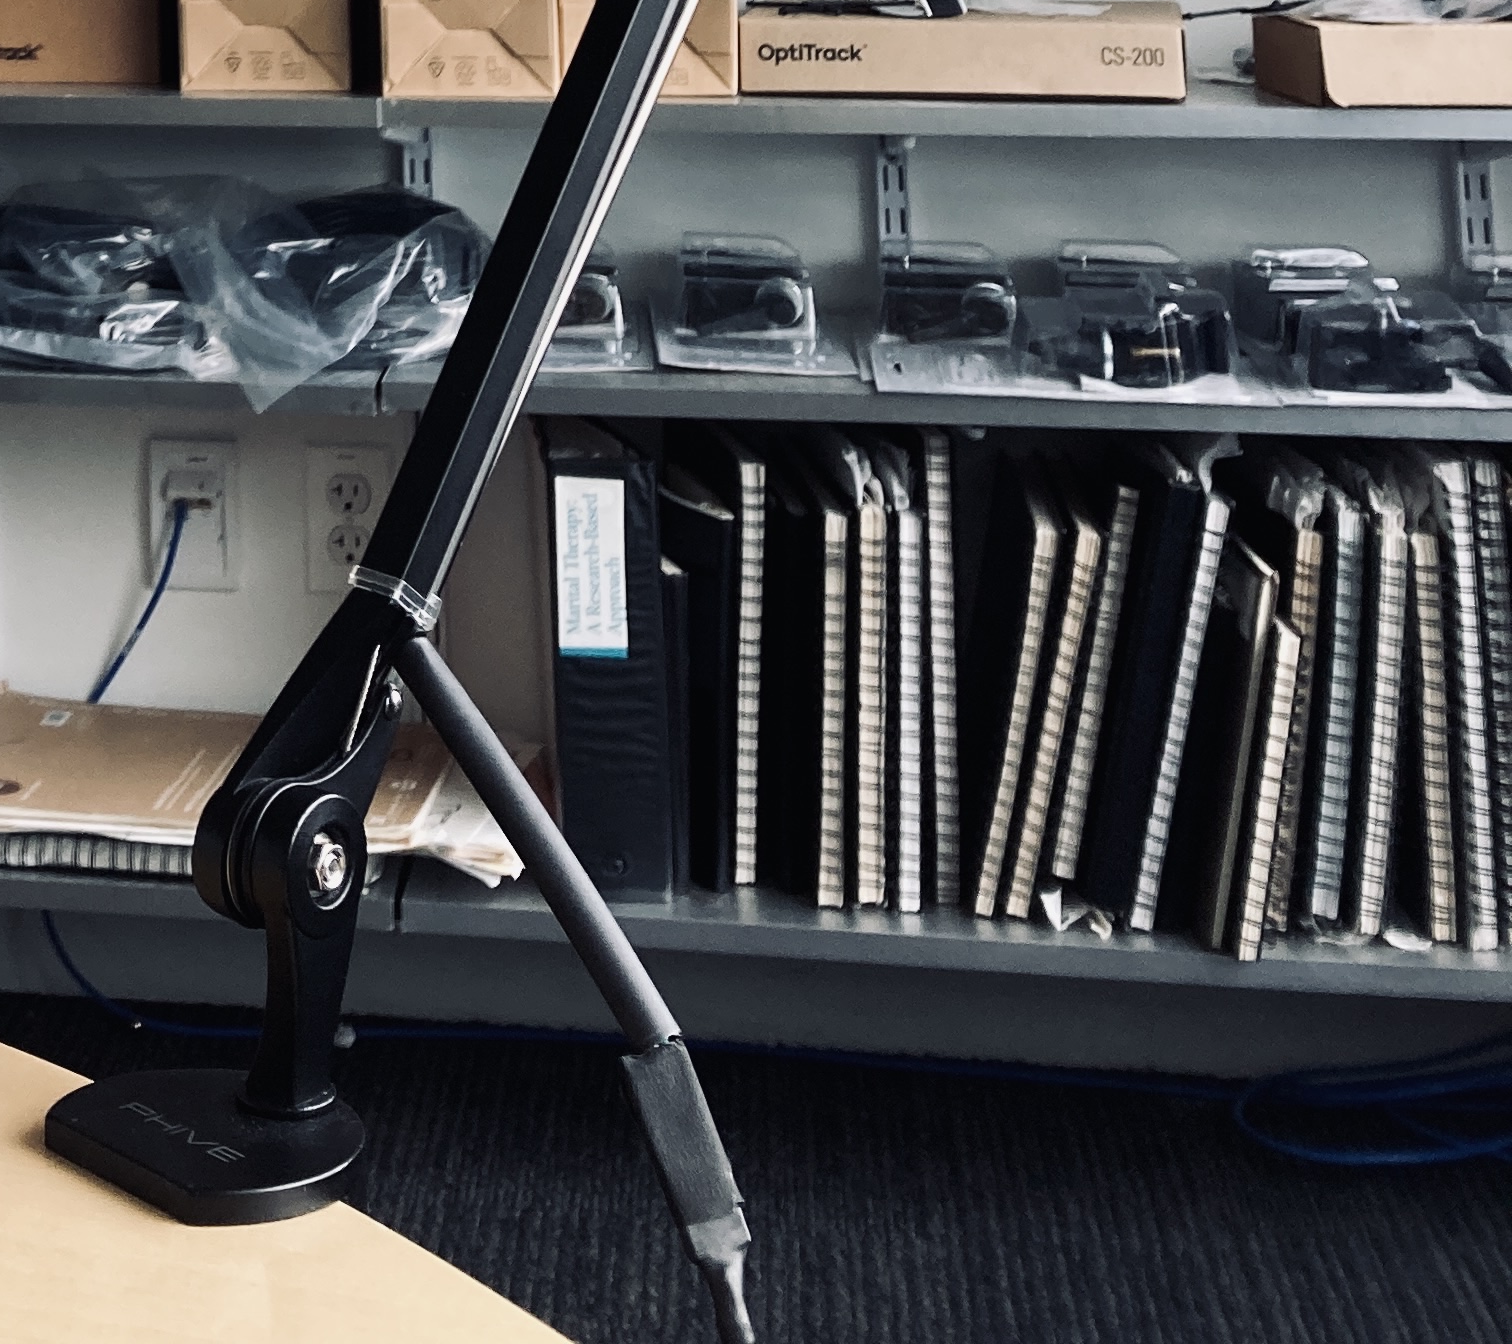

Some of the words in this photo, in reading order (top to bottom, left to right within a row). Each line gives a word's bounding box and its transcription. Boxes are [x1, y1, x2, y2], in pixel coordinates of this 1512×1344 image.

[757, 41, 866, 66] OptiTrack
[1100, 44, 1166, 69] CS-200
[582, 492, 601, 616] Research-Based
[564, 577, 581, 635] Marital
[604, 556, 626, 635] Approach
[585, 621, 601, 635] A
[117, 1100, 246, 1164] PHIVE
